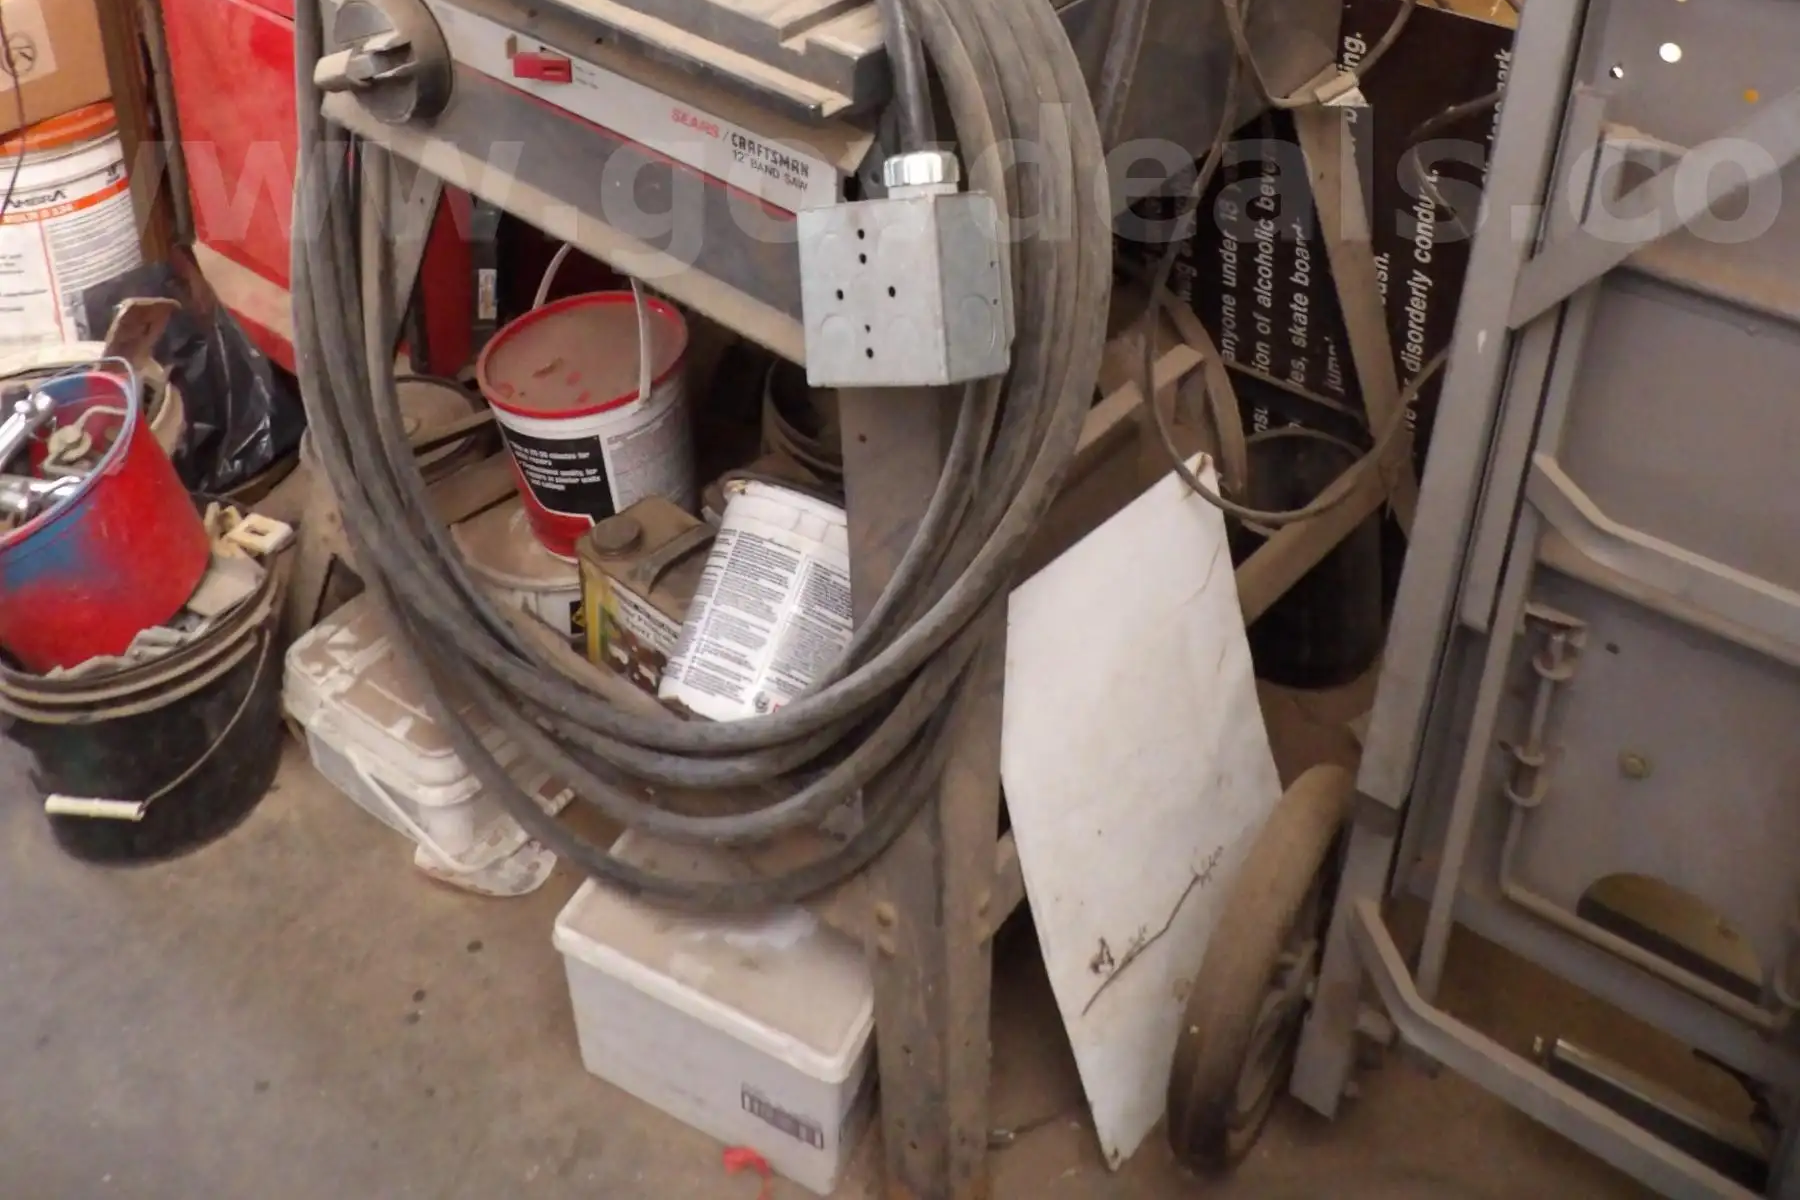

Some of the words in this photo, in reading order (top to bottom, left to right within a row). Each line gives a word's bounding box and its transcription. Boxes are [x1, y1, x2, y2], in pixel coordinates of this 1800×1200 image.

[670, 107, 720, 139] SEARS
[730, 131, 810, 180] CRAFTSMAN
[750, 158, 781, 180] BAND
[783, 173, 809, 191] SAW
[1412, 168, 1439, 264] condut.
[1219, 229, 1239, 288] under
[1253, 218, 1275, 309] alcoholic
[1221, 293, 1240, 361] anyone
[1252, 311, 1272, 336] of
[1288, 291, 1311, 349] skate
[1400, 269, 1433, 373] disorderly
